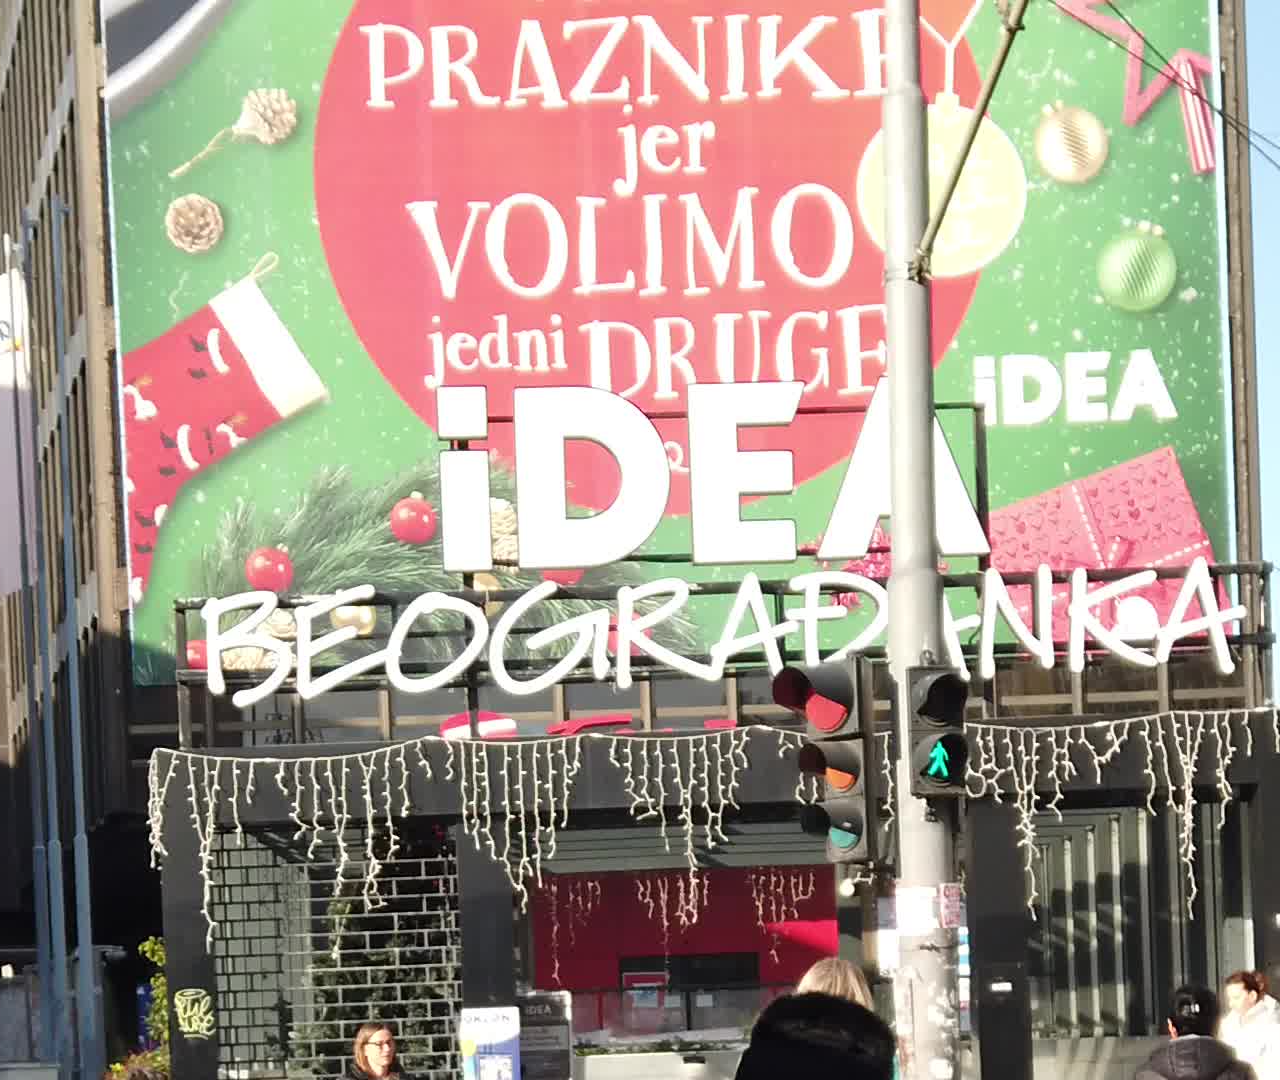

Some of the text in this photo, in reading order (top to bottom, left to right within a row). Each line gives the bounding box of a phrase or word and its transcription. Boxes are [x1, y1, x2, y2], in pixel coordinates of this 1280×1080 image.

[612, 104, 717, 197] jer
[405, 183, 854, 299] VOLIMO
[424, 304, 887, 399] jedni DRUGE
